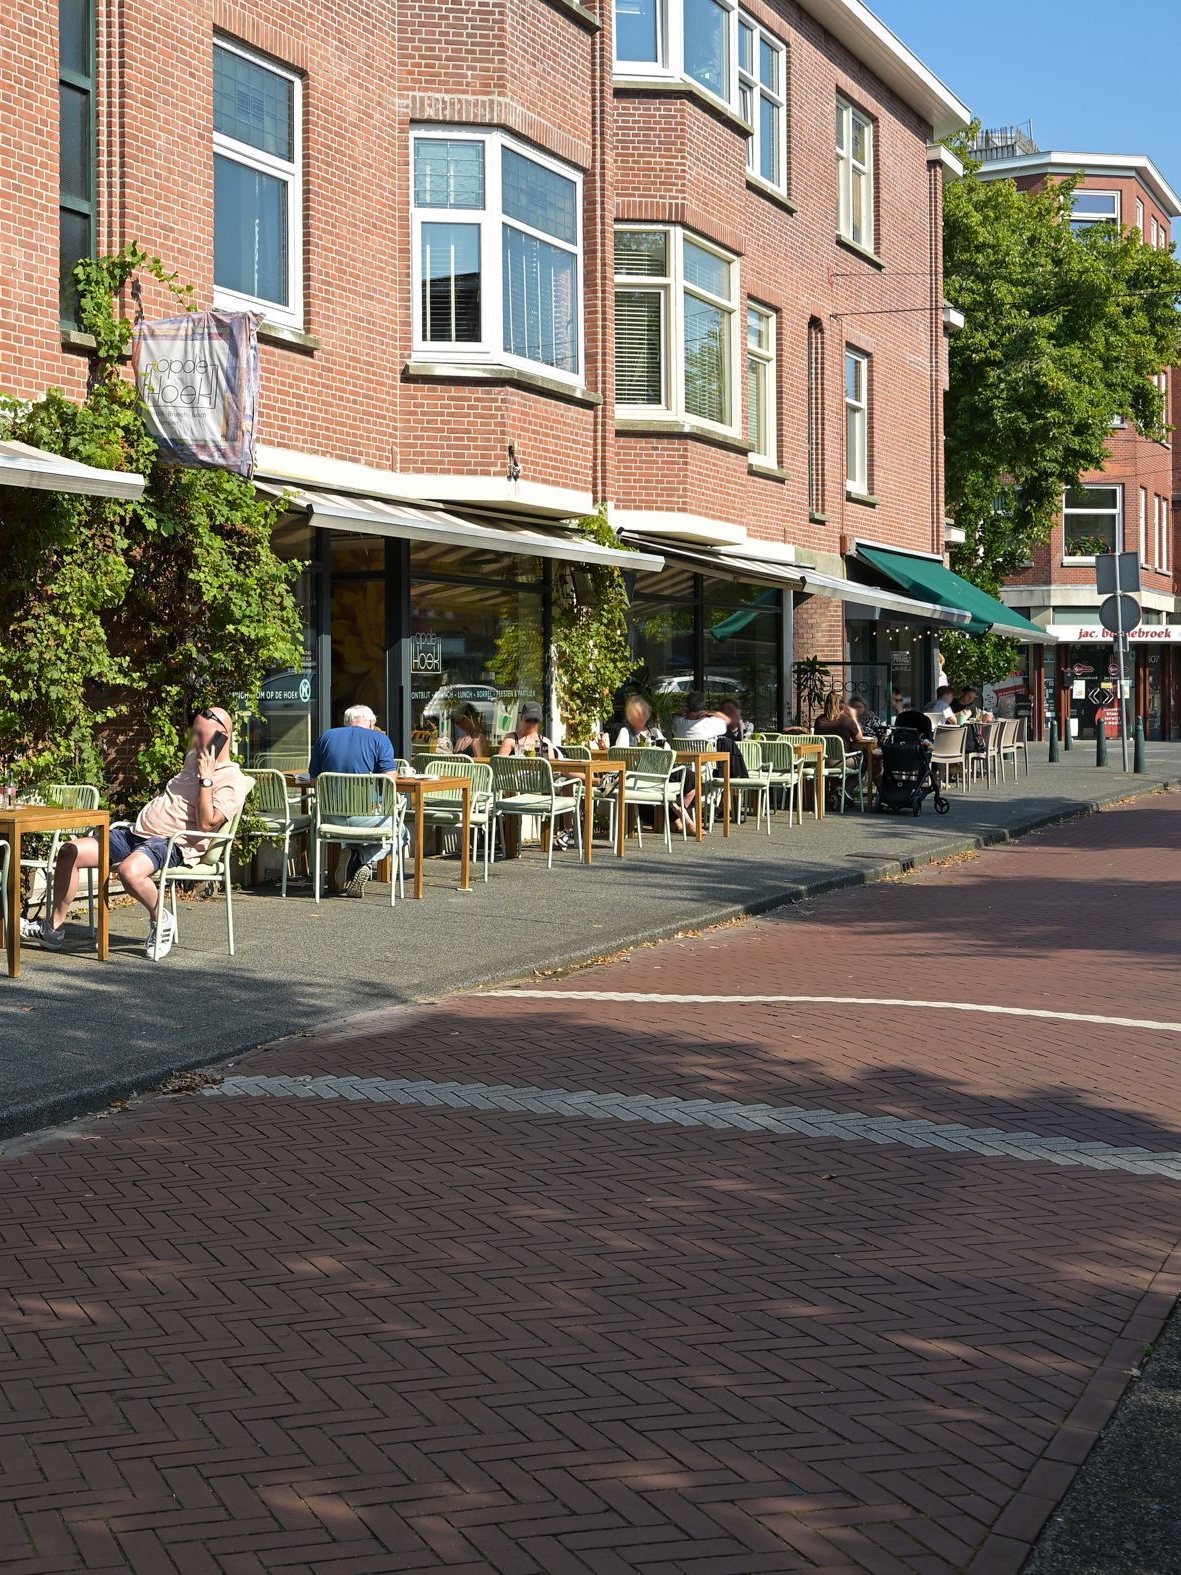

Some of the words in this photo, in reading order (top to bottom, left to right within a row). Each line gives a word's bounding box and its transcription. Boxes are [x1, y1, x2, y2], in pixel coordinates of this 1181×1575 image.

[156, 354, 208, 378] opde
[415, 627, 437, 650] opde
[1078, 628, 1099, 640] jac.
[1101, 627, 1172, 639] beebroek
[412, 638, 441, 670] Hoek
[266, 691, 274, 700] OP
[275, 691, 282, 700] DE
[283, 691, 298, 700] HOEK
[457, 691, 473, 699] LUNCH
[476, 690, 493, 698] BORREL
